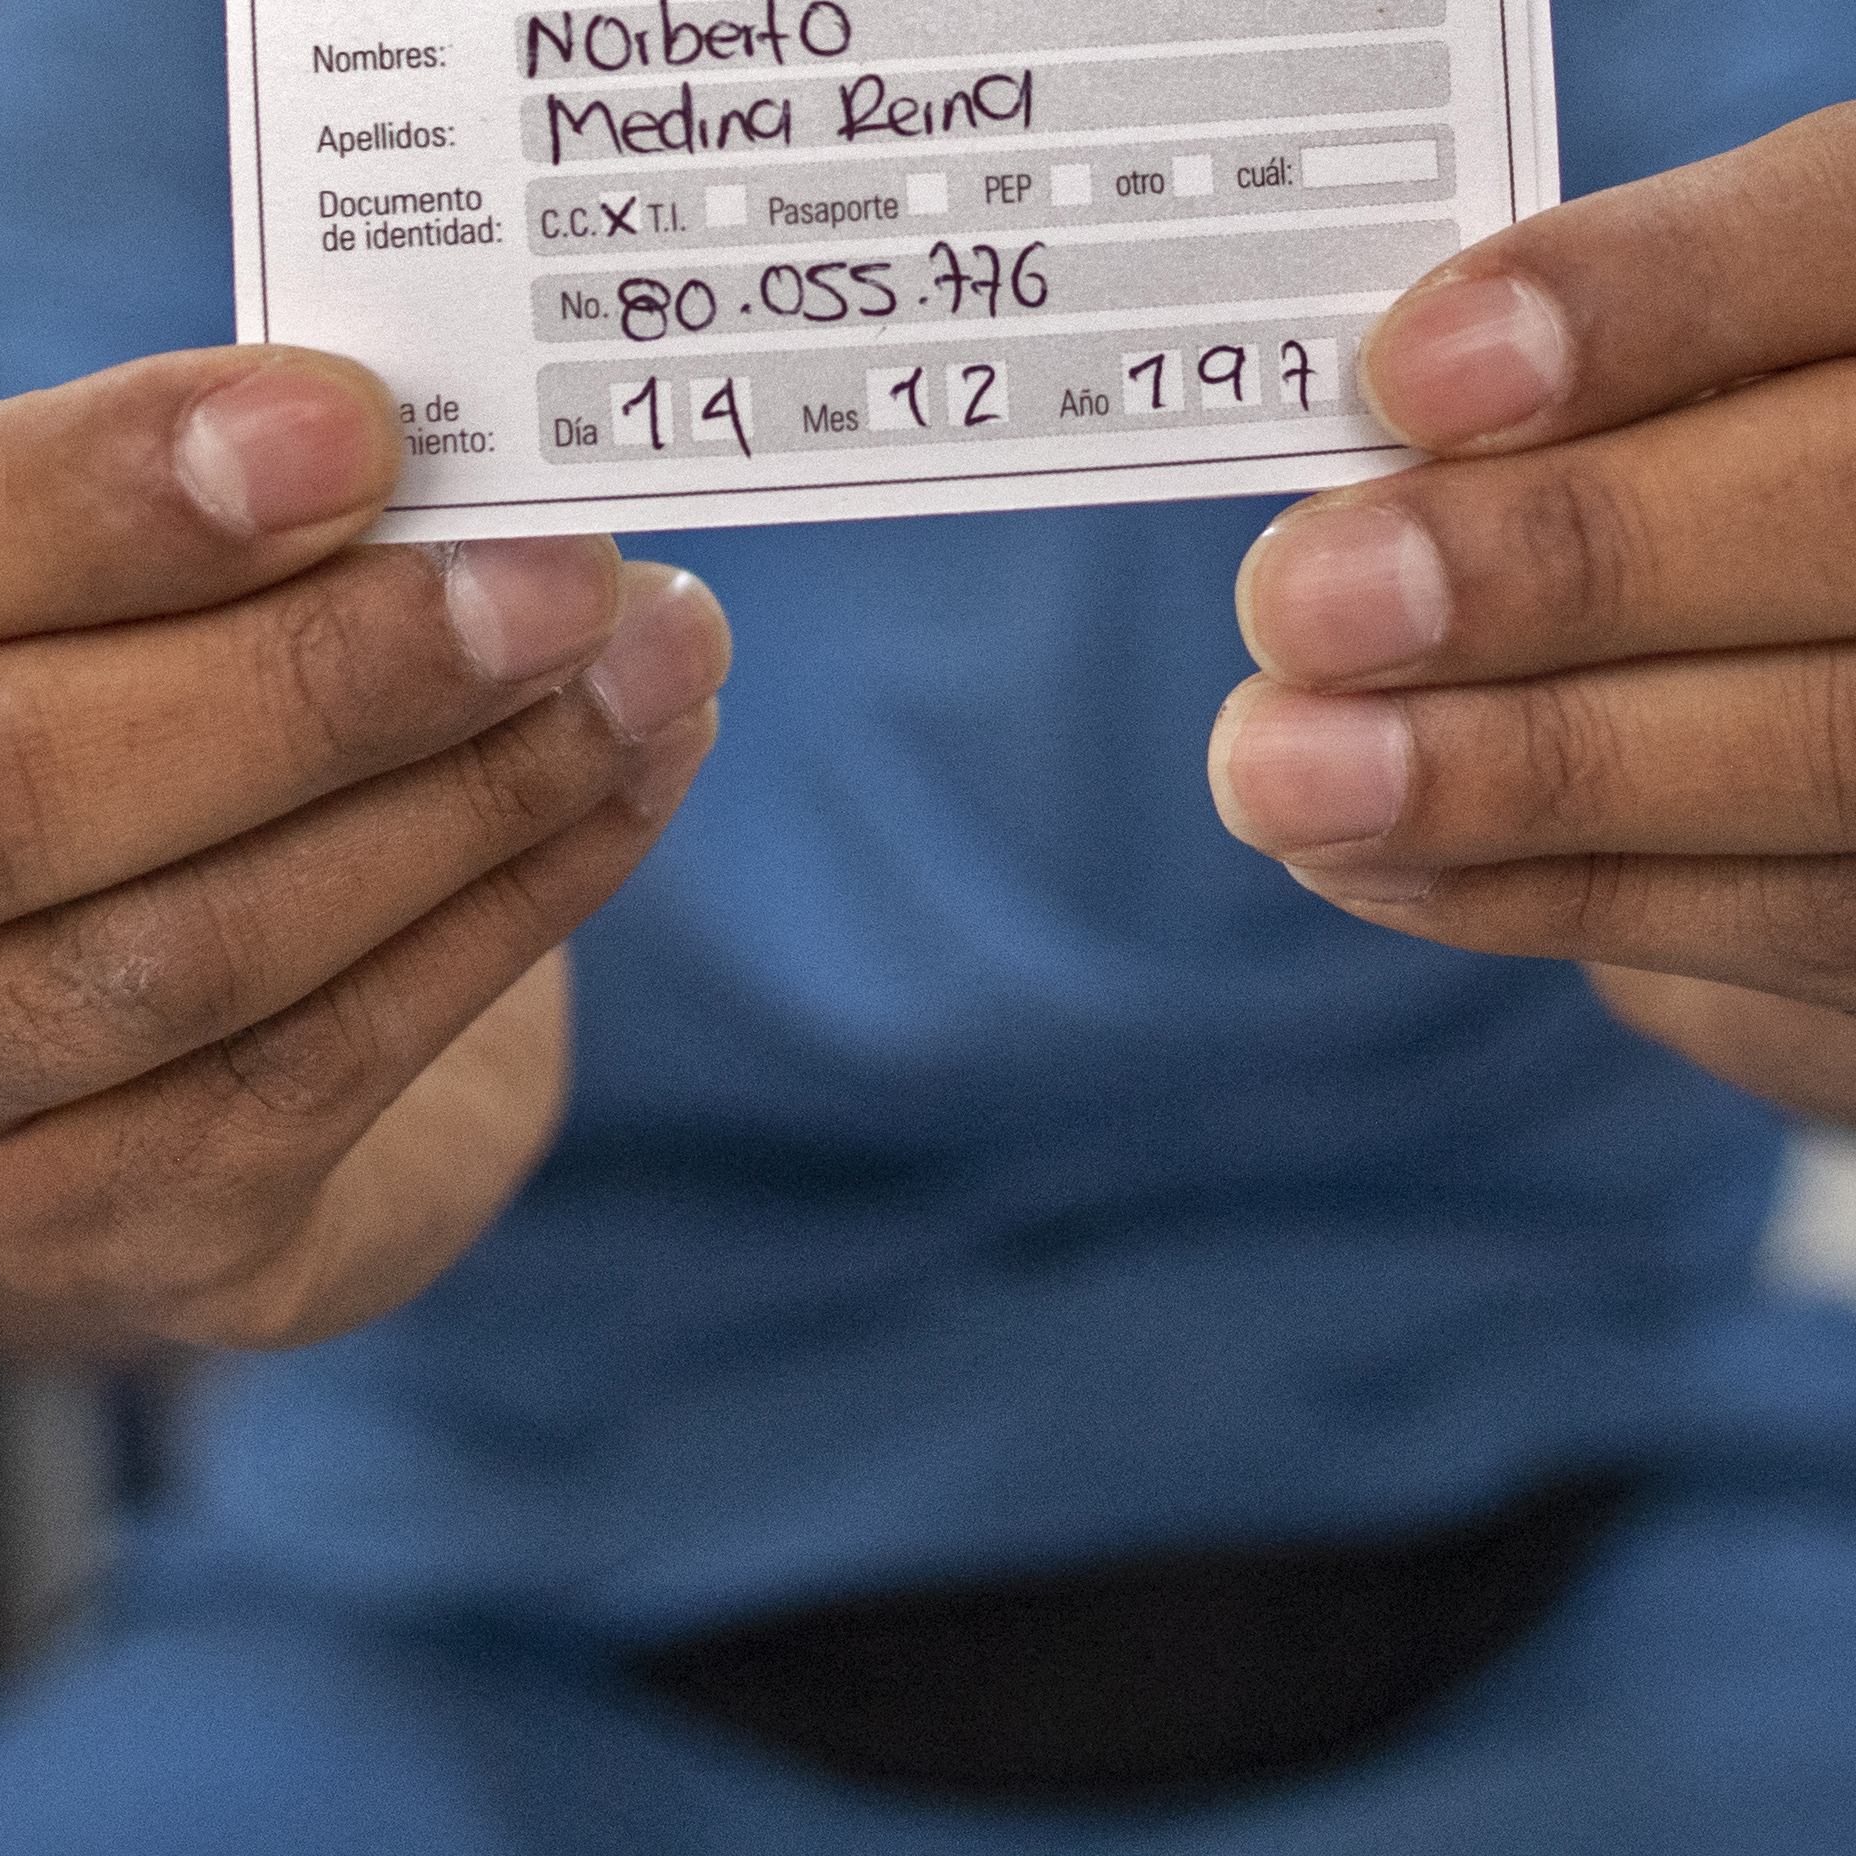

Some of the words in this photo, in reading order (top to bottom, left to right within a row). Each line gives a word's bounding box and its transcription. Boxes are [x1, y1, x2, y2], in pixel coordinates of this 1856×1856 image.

[313, 42, 447, 73] Nombres:
[546, 81, 792, 166] Medina
[837, 69, 1033, 142] Reina
[317, 121, 456, 159] Apellidos:
[319, 187, 483, 223] Documento
[646, 202, 686, 233] T.I.
[768, 195, 899, 229] Pasaporte
[984, 173, 1032, 204] PEP
[1115, 170, 1165, 197] otro
[1237, 156, 1294, 189] cuál:
[322, 223, 356, 252] de
[365, 215, 503, 250] identidad:
[540, 207, 597, 240] C.C.
[560, 291, 609, 320] No.
[425, 394, 459, 423] de
[802, 403, 859, 433] Mes
[1059, 388, 1110, 418] Año
[554, 416, 598, 448] Día
